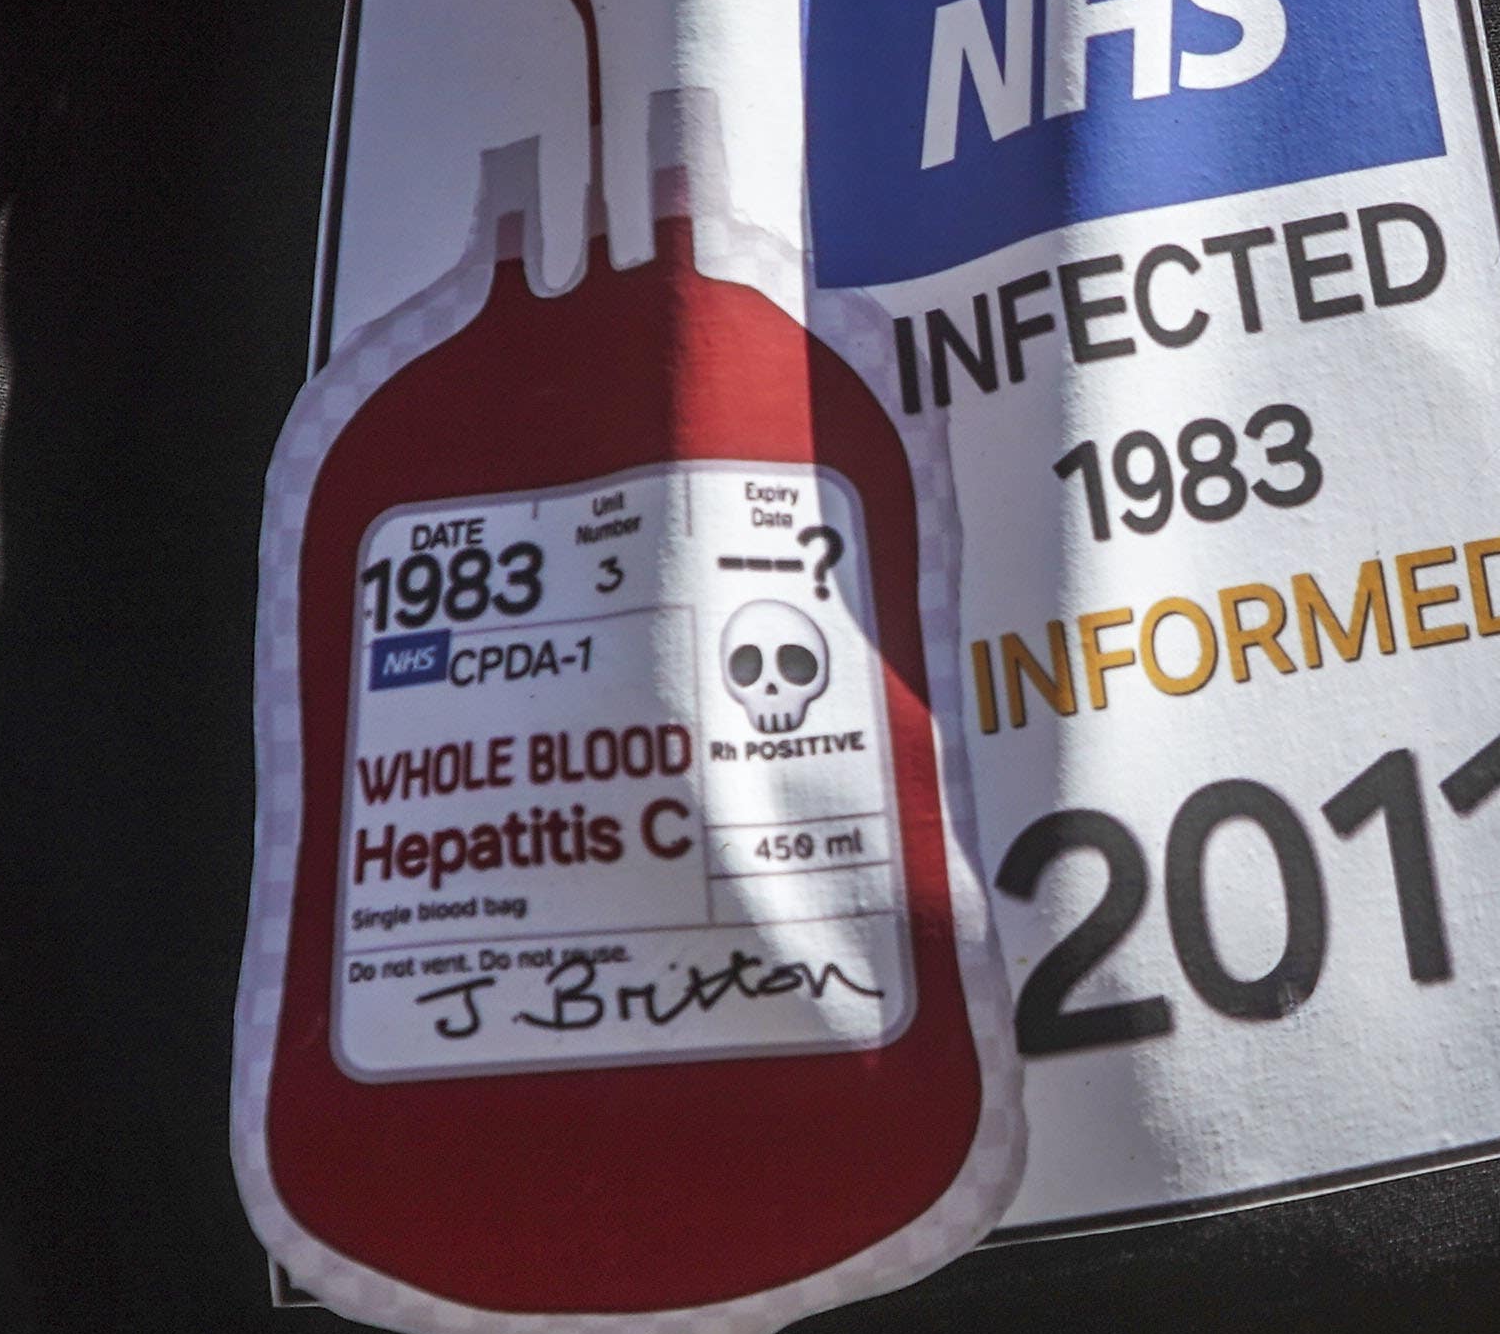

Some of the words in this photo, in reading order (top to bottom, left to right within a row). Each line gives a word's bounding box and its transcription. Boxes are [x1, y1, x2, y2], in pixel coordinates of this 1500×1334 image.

[895, 202, 1447, 415] INFECTED
[1052, 403, 1324, 543] 1983
[593, 491, 624, 517] Unit
[744, 481, 799, 505] Expiry
[410, 517, 486, 551] DATE
[575, 516, 642, 545] Number
[751, 506, 793, 528] Date
[361, 541, 546, 632] 1983
[596, 555, 625, 595] 3
[382, 645, 438, 677] NHS
[450, 636, 593, 687] CPDA-1
[357, 736, 516, 806] WHOLE
[528, 723, 693, 785] BLOOD
[711, 740, 738, 763] Rh
[745, 731, 866, 761] POSITIVE
[353, 803, 624, 891] Hepatitis
[640, 797, 694, 860] C
[755, 833, 816, 862] 450
[826, 826, 864, 854] ml
[352, 908, 412, 931] Single
[417, 898, 477, 922] blood
[483, 897, 528, 919] bag
[349, 961, 376, 983] Do
[382, 957, 415, 979] not
[421, 954, 471, 975] vent.
[479, 949, 512, 971] Do
[517, 947, 555, 968] not
